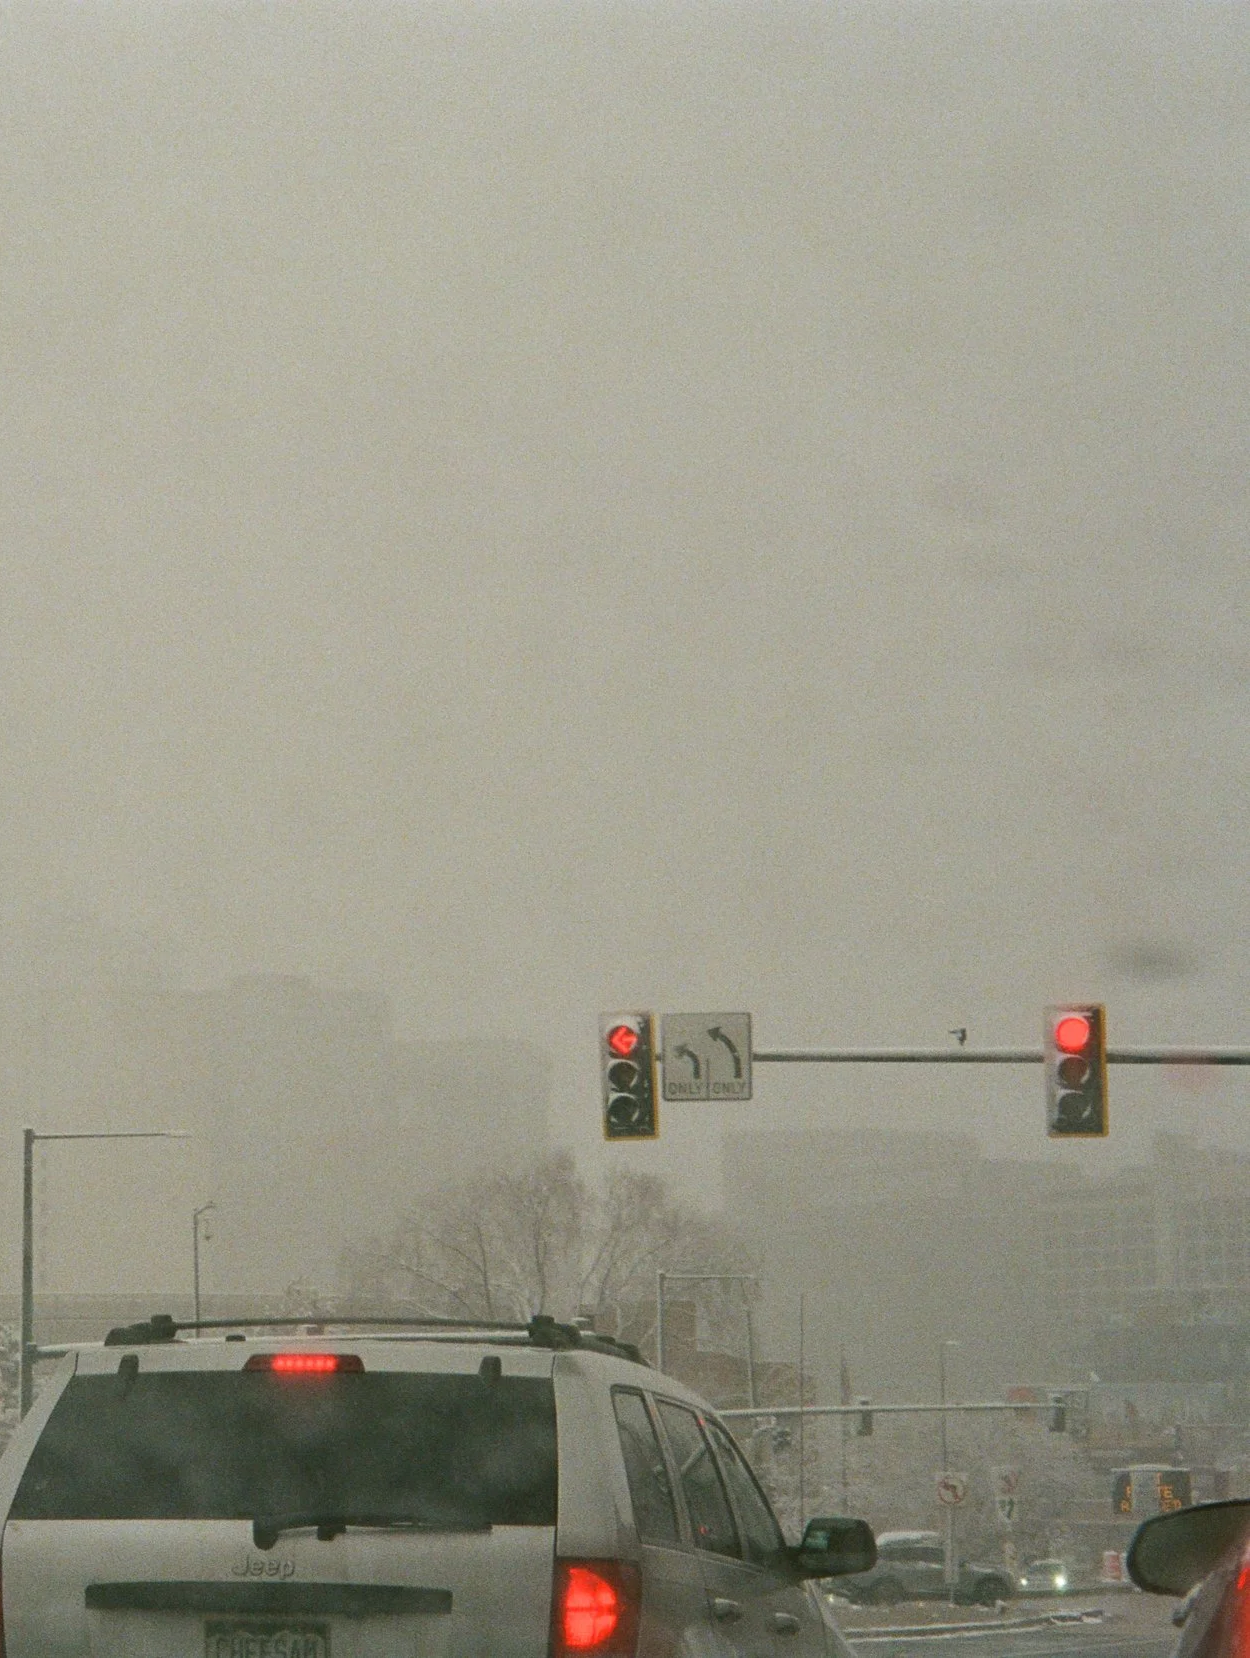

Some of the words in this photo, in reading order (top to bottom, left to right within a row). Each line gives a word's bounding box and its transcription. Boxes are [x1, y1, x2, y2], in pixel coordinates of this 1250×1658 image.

[668, 1082, 703, 1095] ONLY
[712, 1082, 747, 1095] ONLY
[231, 1554, 295, 1580] Jeep
